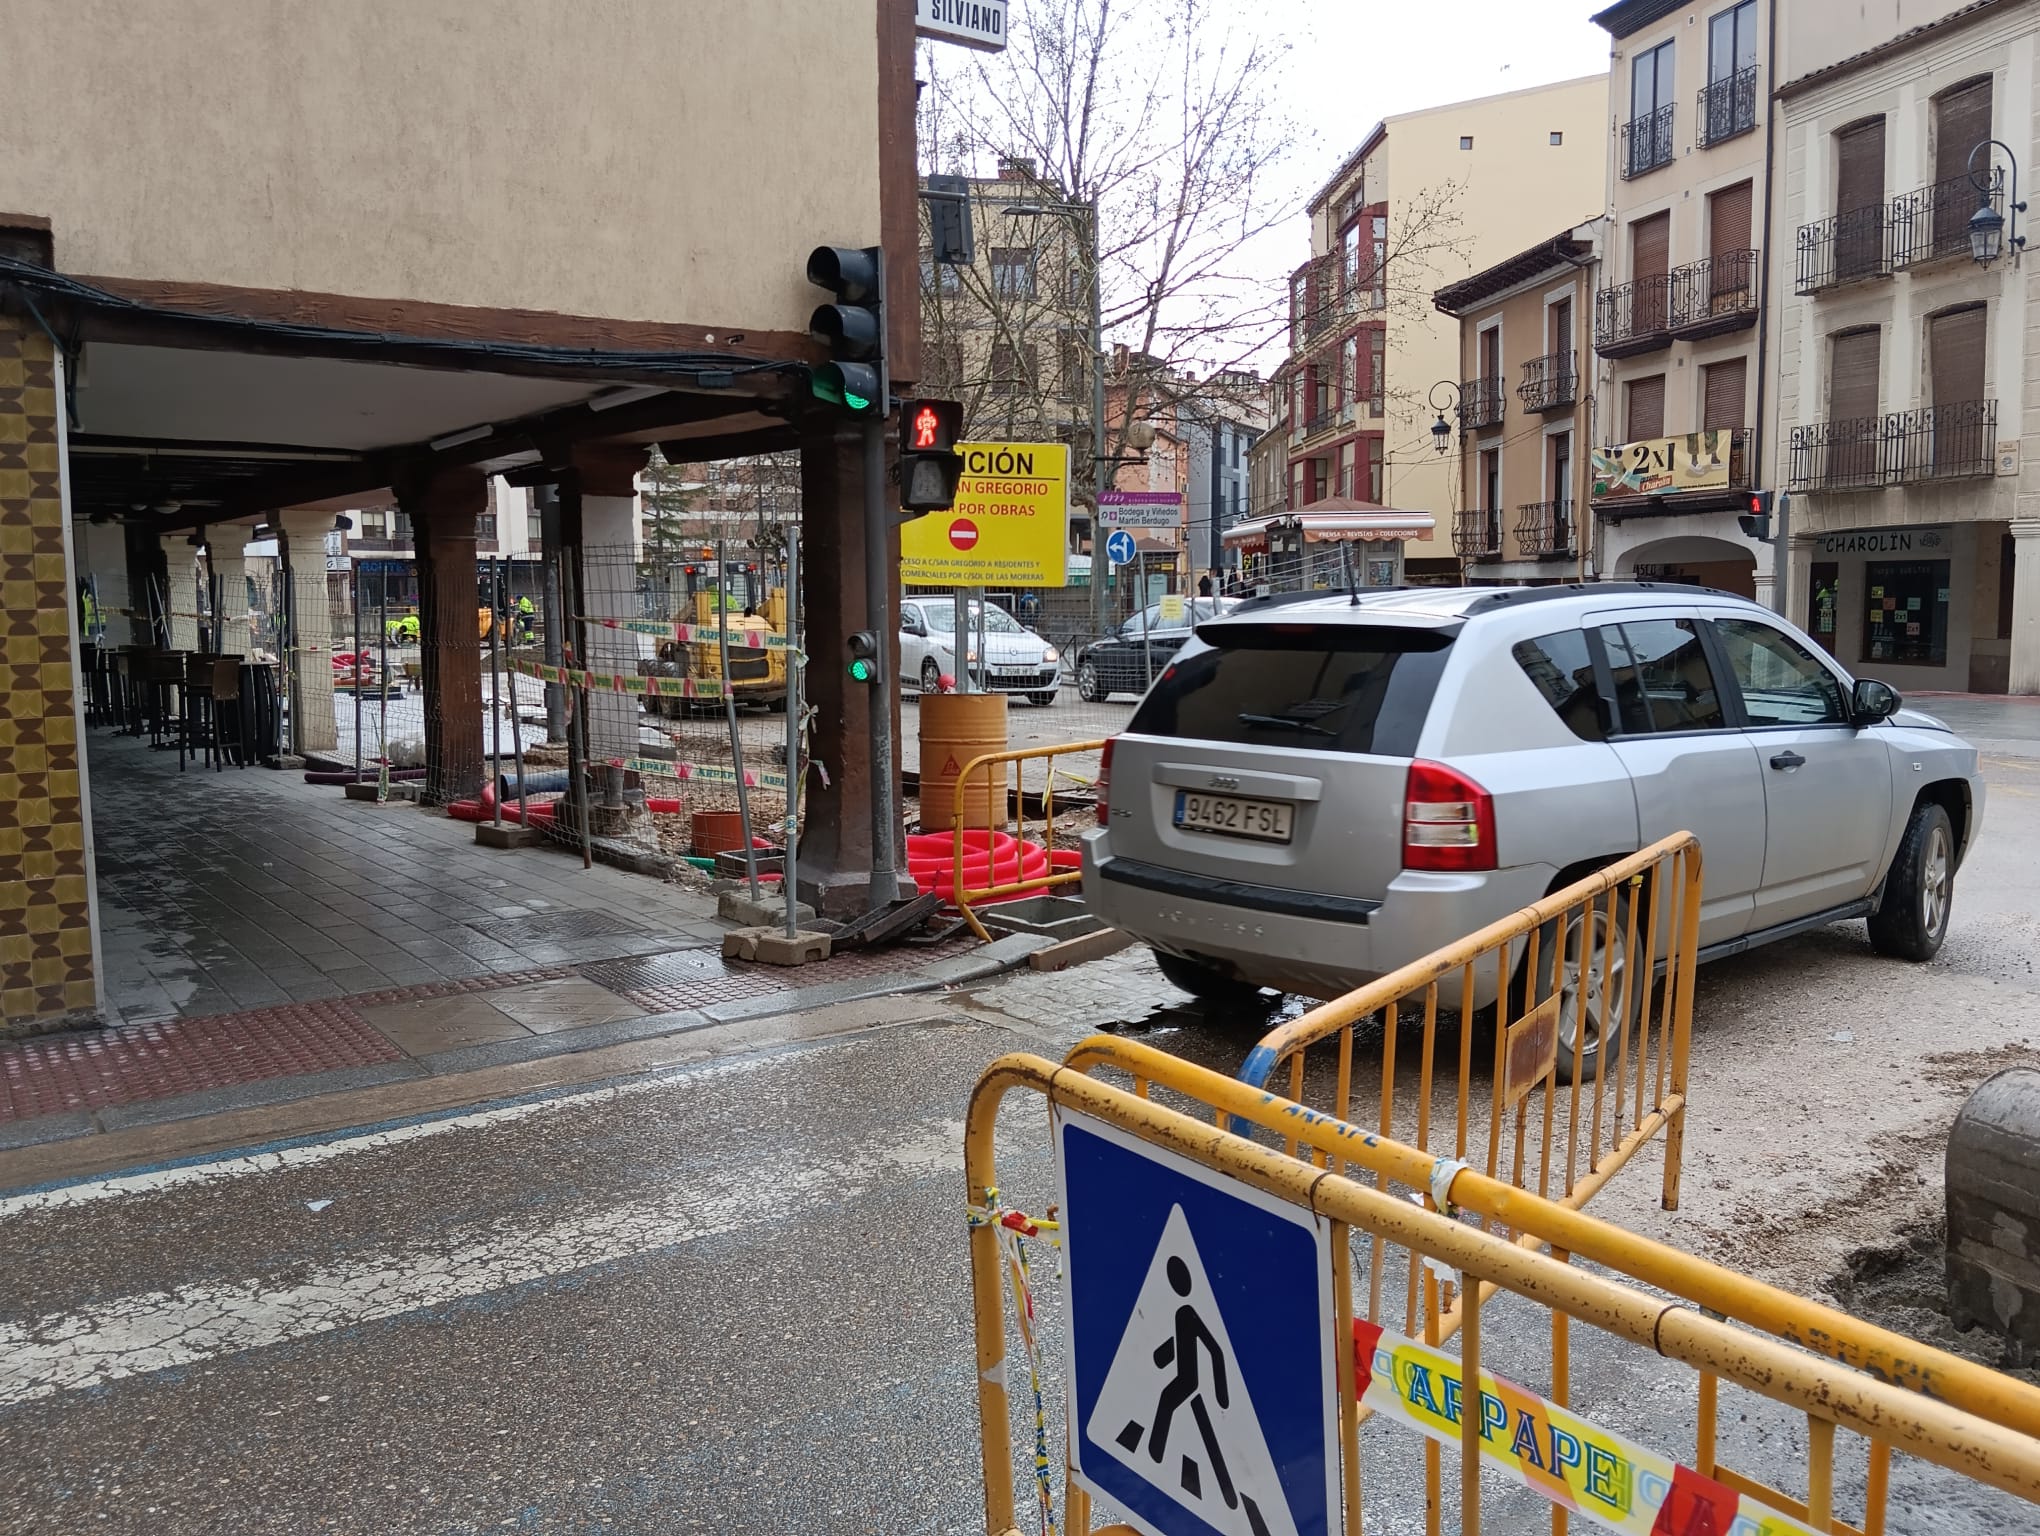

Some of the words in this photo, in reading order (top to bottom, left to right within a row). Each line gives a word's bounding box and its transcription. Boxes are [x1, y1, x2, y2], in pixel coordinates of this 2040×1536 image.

[932, 0, 1001, 35] SILVIANO
[961, 447, 1033, 475] CIÓN
[1633, 442, 1675, 475] 2x1
[975, 481, 1048, 496] GREGORIO
[959, 503, 985, 514] POR
[989, 504, 1035, 516] OBRAS
[1119, 507, 1144, 517] Bodega
[1151, 507, 1178, 516] Viñedos
[1141, 517, 1170, 526] Berdugo
[903, 558, 920, 566] CESO
[950, 559, 985, 568] GREGORIO
[994, 560, 1034, 568] RESIDENTES
[901, 569, 948, 579] COMERCIALES
[949, 571, 961, 579] POR
[996, 573, 1008, 581] LAS
[764, 775, 785, 787] ARPA
[1188, 797, 1239, 828] 9462
[1243, 804, 1285, 834] FSL
